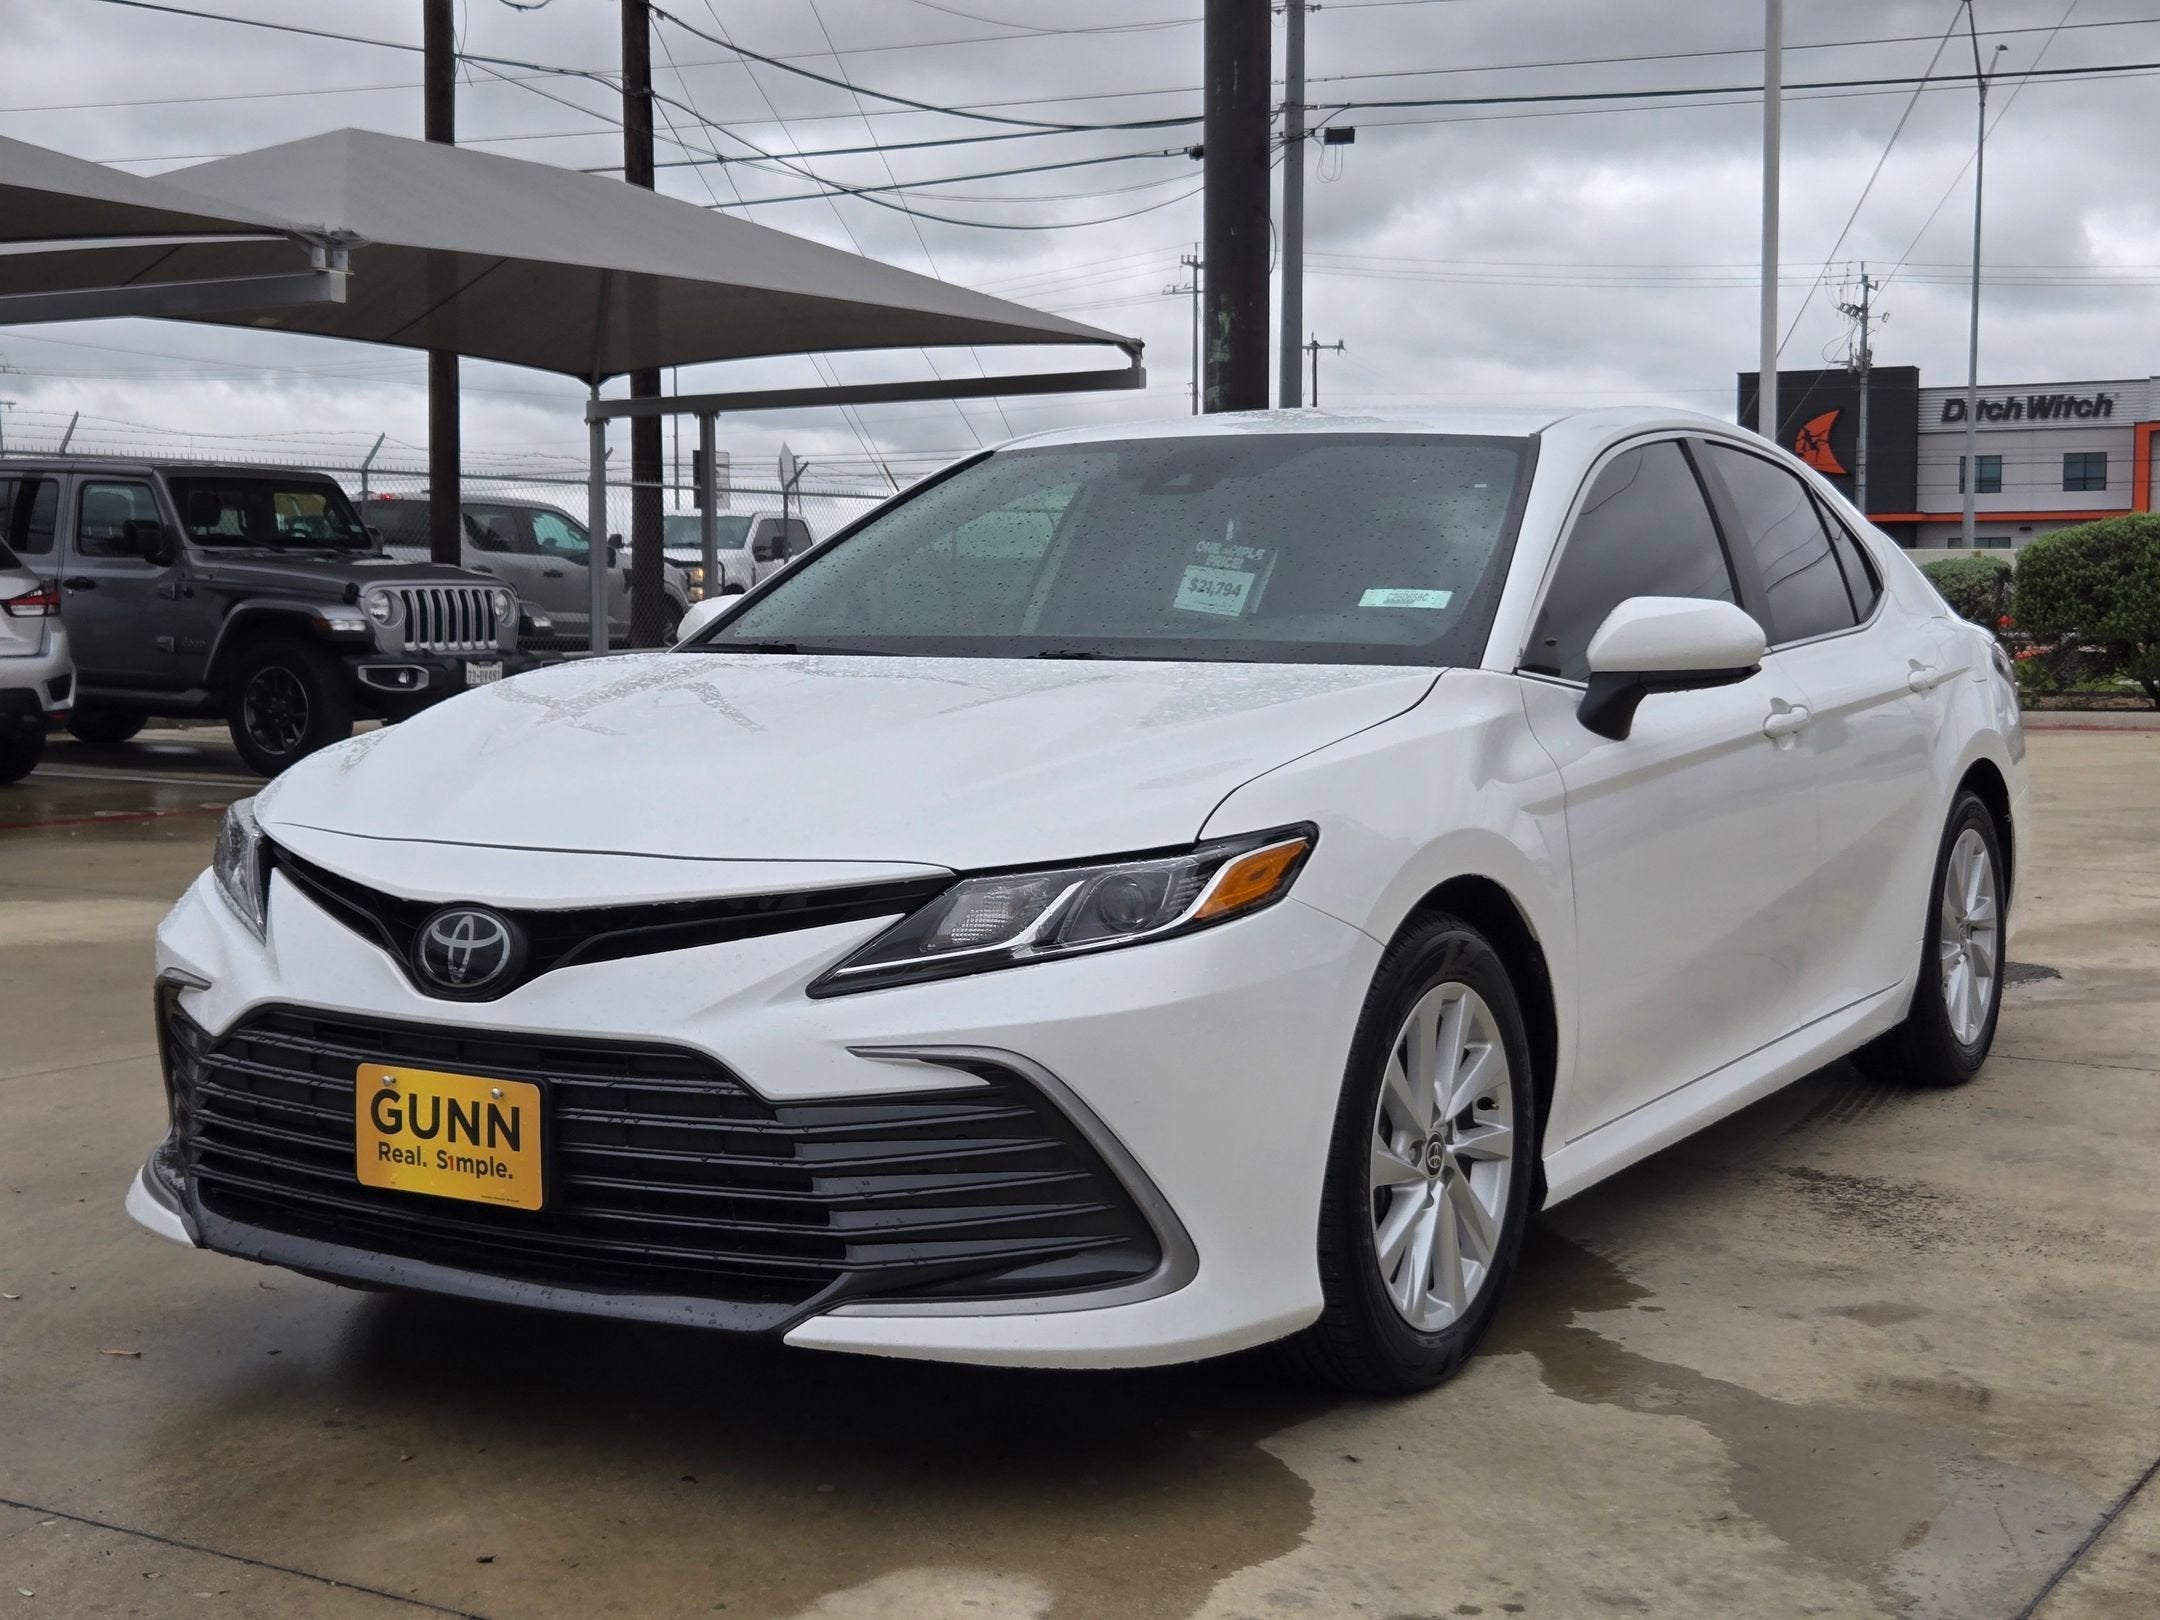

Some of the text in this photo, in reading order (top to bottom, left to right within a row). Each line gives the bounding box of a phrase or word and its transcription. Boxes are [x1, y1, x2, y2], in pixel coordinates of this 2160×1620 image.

[1940, 393, 2113, 423] Dtch Witch
[1188, 577, 1242, 598] $21,794
[371, 1089, 520, 1152] GUNN
[378, 1141, 427, 1167] Real.
